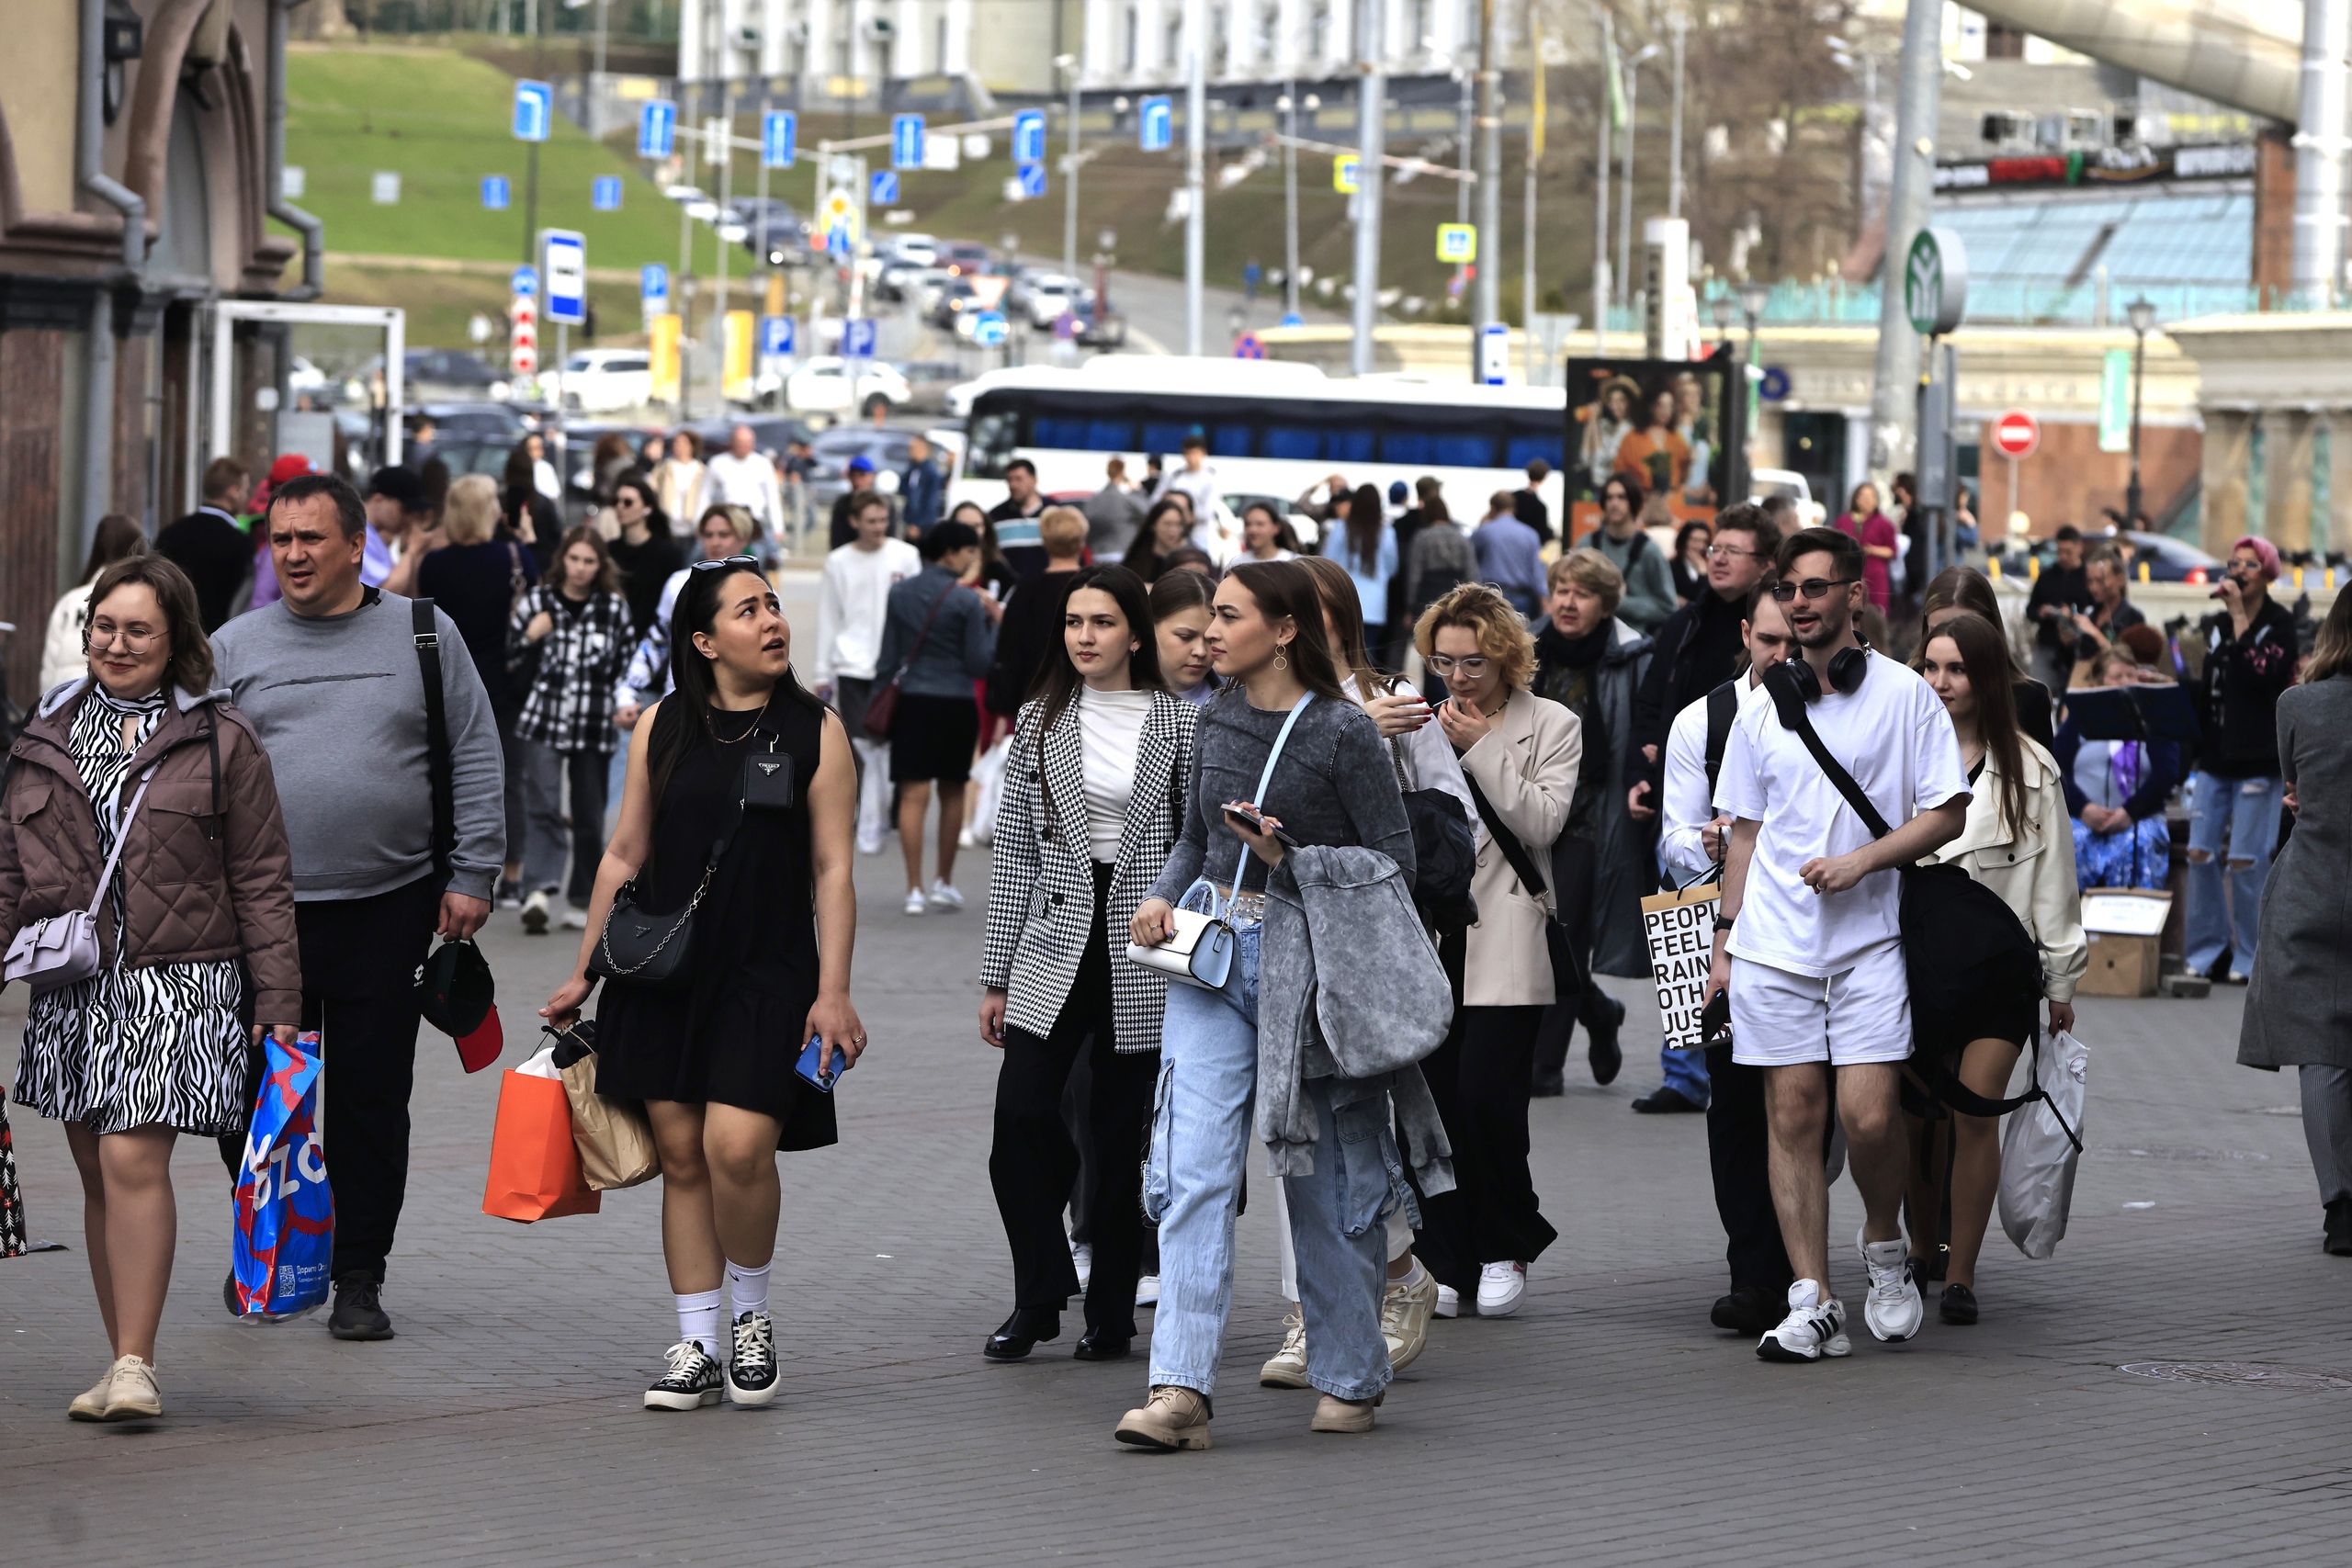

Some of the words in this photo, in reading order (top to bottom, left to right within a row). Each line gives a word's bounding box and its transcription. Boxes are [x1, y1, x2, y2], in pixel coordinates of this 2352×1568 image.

[1649, 930, 1711, 960] FEEL
[1654, 953, 1712, 986] RAIN
[1657, 979, 1709, 1010] OTH
